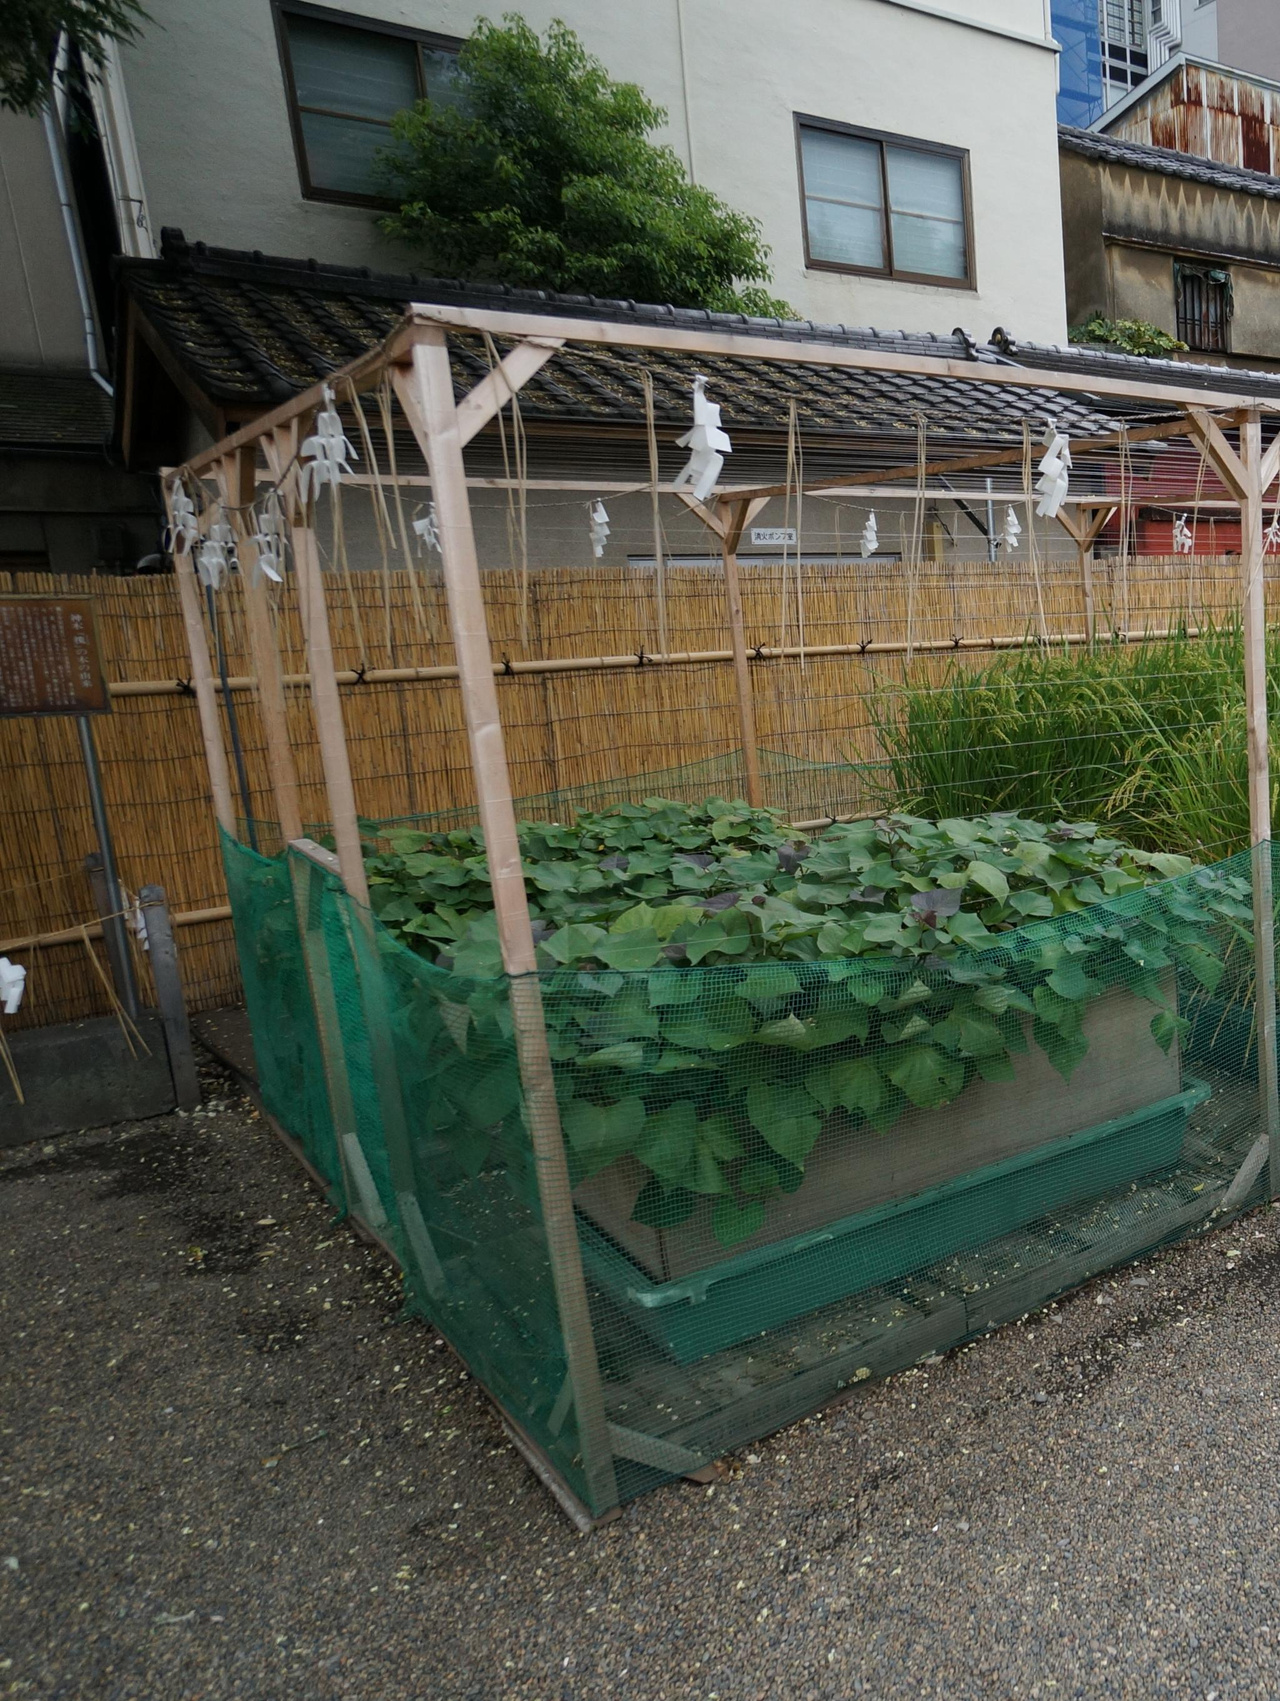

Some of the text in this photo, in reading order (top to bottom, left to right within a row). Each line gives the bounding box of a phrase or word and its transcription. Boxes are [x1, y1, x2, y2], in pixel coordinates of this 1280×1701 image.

[754, 532, 794, 541] 消火ポンプ室
